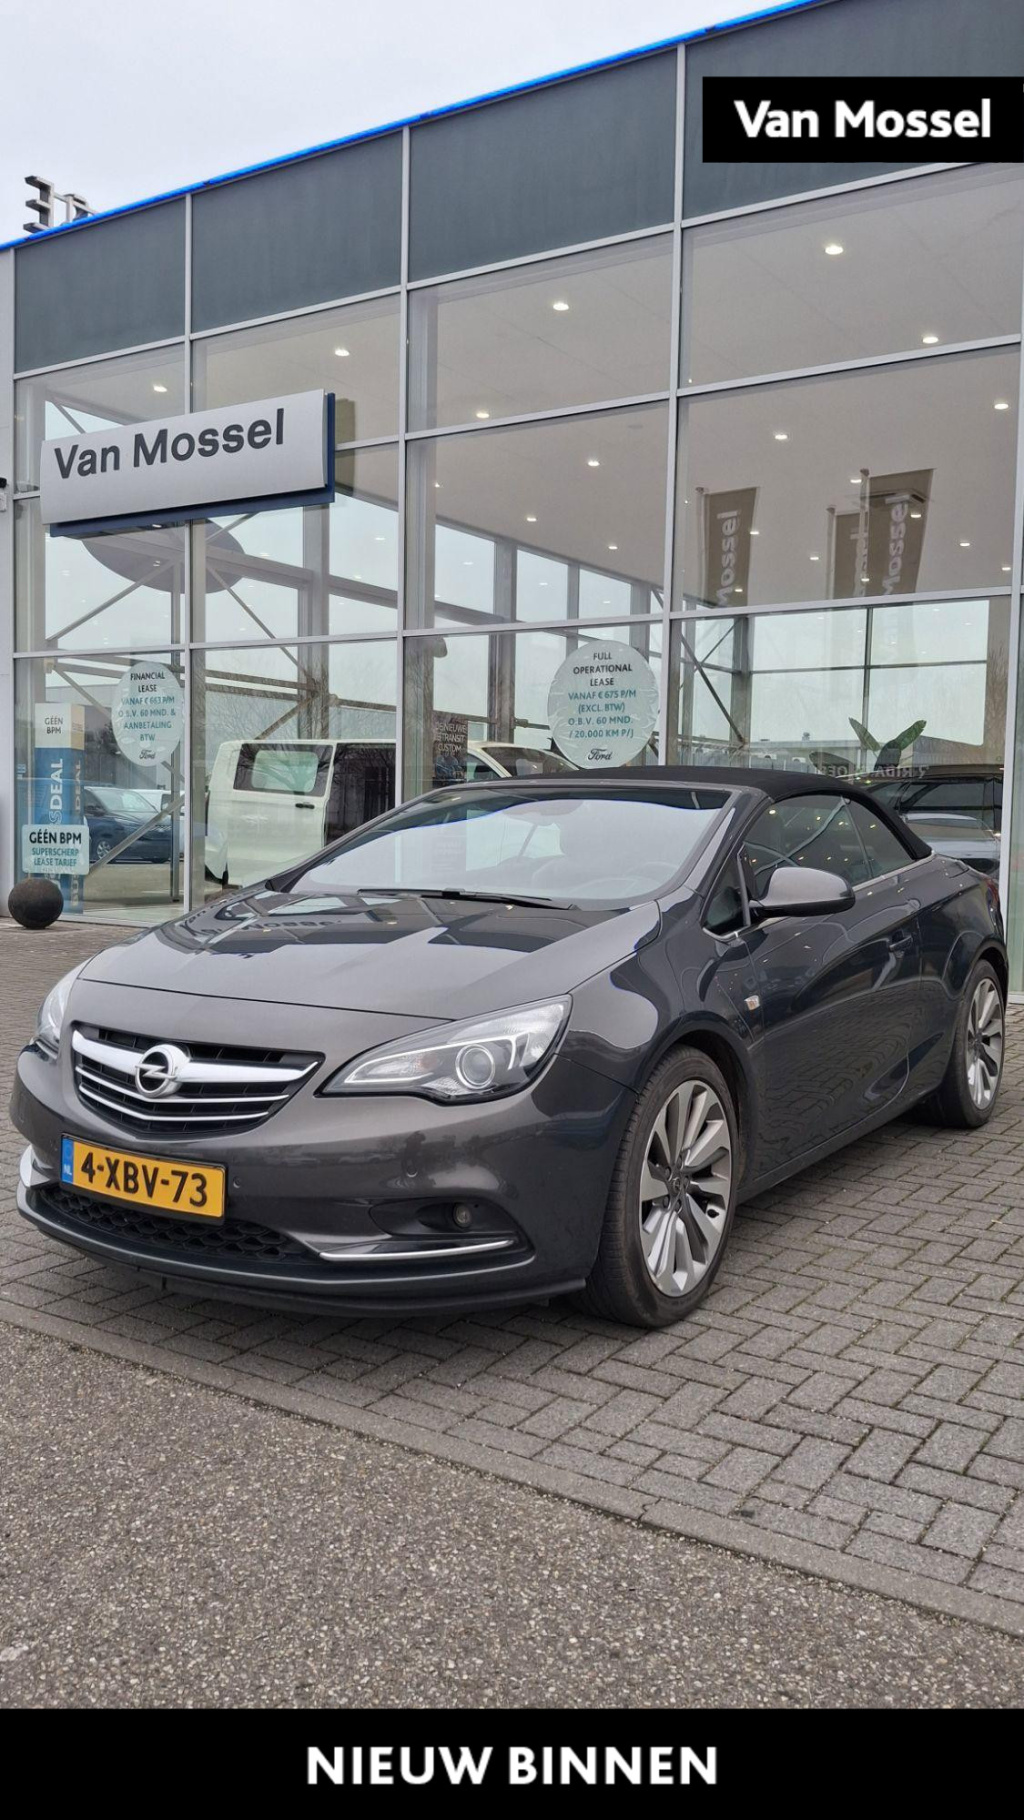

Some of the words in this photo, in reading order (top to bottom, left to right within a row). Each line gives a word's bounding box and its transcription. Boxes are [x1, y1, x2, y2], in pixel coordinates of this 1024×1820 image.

[54, 444, 120, 480] Van
[133, 408, 284, 468] Mossel
[593, 652, 612, 660] FULL
[573, 664, 633, 674] OPERATIONAL
[130, 671, 165, 680] FINANCIAL
[590, 678, 614, 686] LEASE
[138, 684, 157, 692] LEASE
[568, 691, 596, 700] VANAF
[598, 691, 603, 699] €
[604, 691, 618, 699] 675
[621, 690, 636, 698] P/M
[578, 704, 603, 714] (EXCL.
[605, 702, 625, 712] BTW)
[44, 715, 63, 725] GÉÉN
[124, 721, 172, 729] AANBETALING
[606, 729, 618, 737] KM
[621, 729, 634, 738] P/J
[139, 750, 156, 759] Ford
[588, 748, 613, 760] Ford
[29, 828, 57, 844] GÉÉN
[60, 832, 82, 844] BPM
[32, 847, 79, 856] SUPERSCHERP
[34, 858, 53, 866] LEASE
[54, 858, 77, 866] TARIEF
[63, 1165, 72, 1175] NL
[81, 1152, 207, 1208] 4-XBV-73
